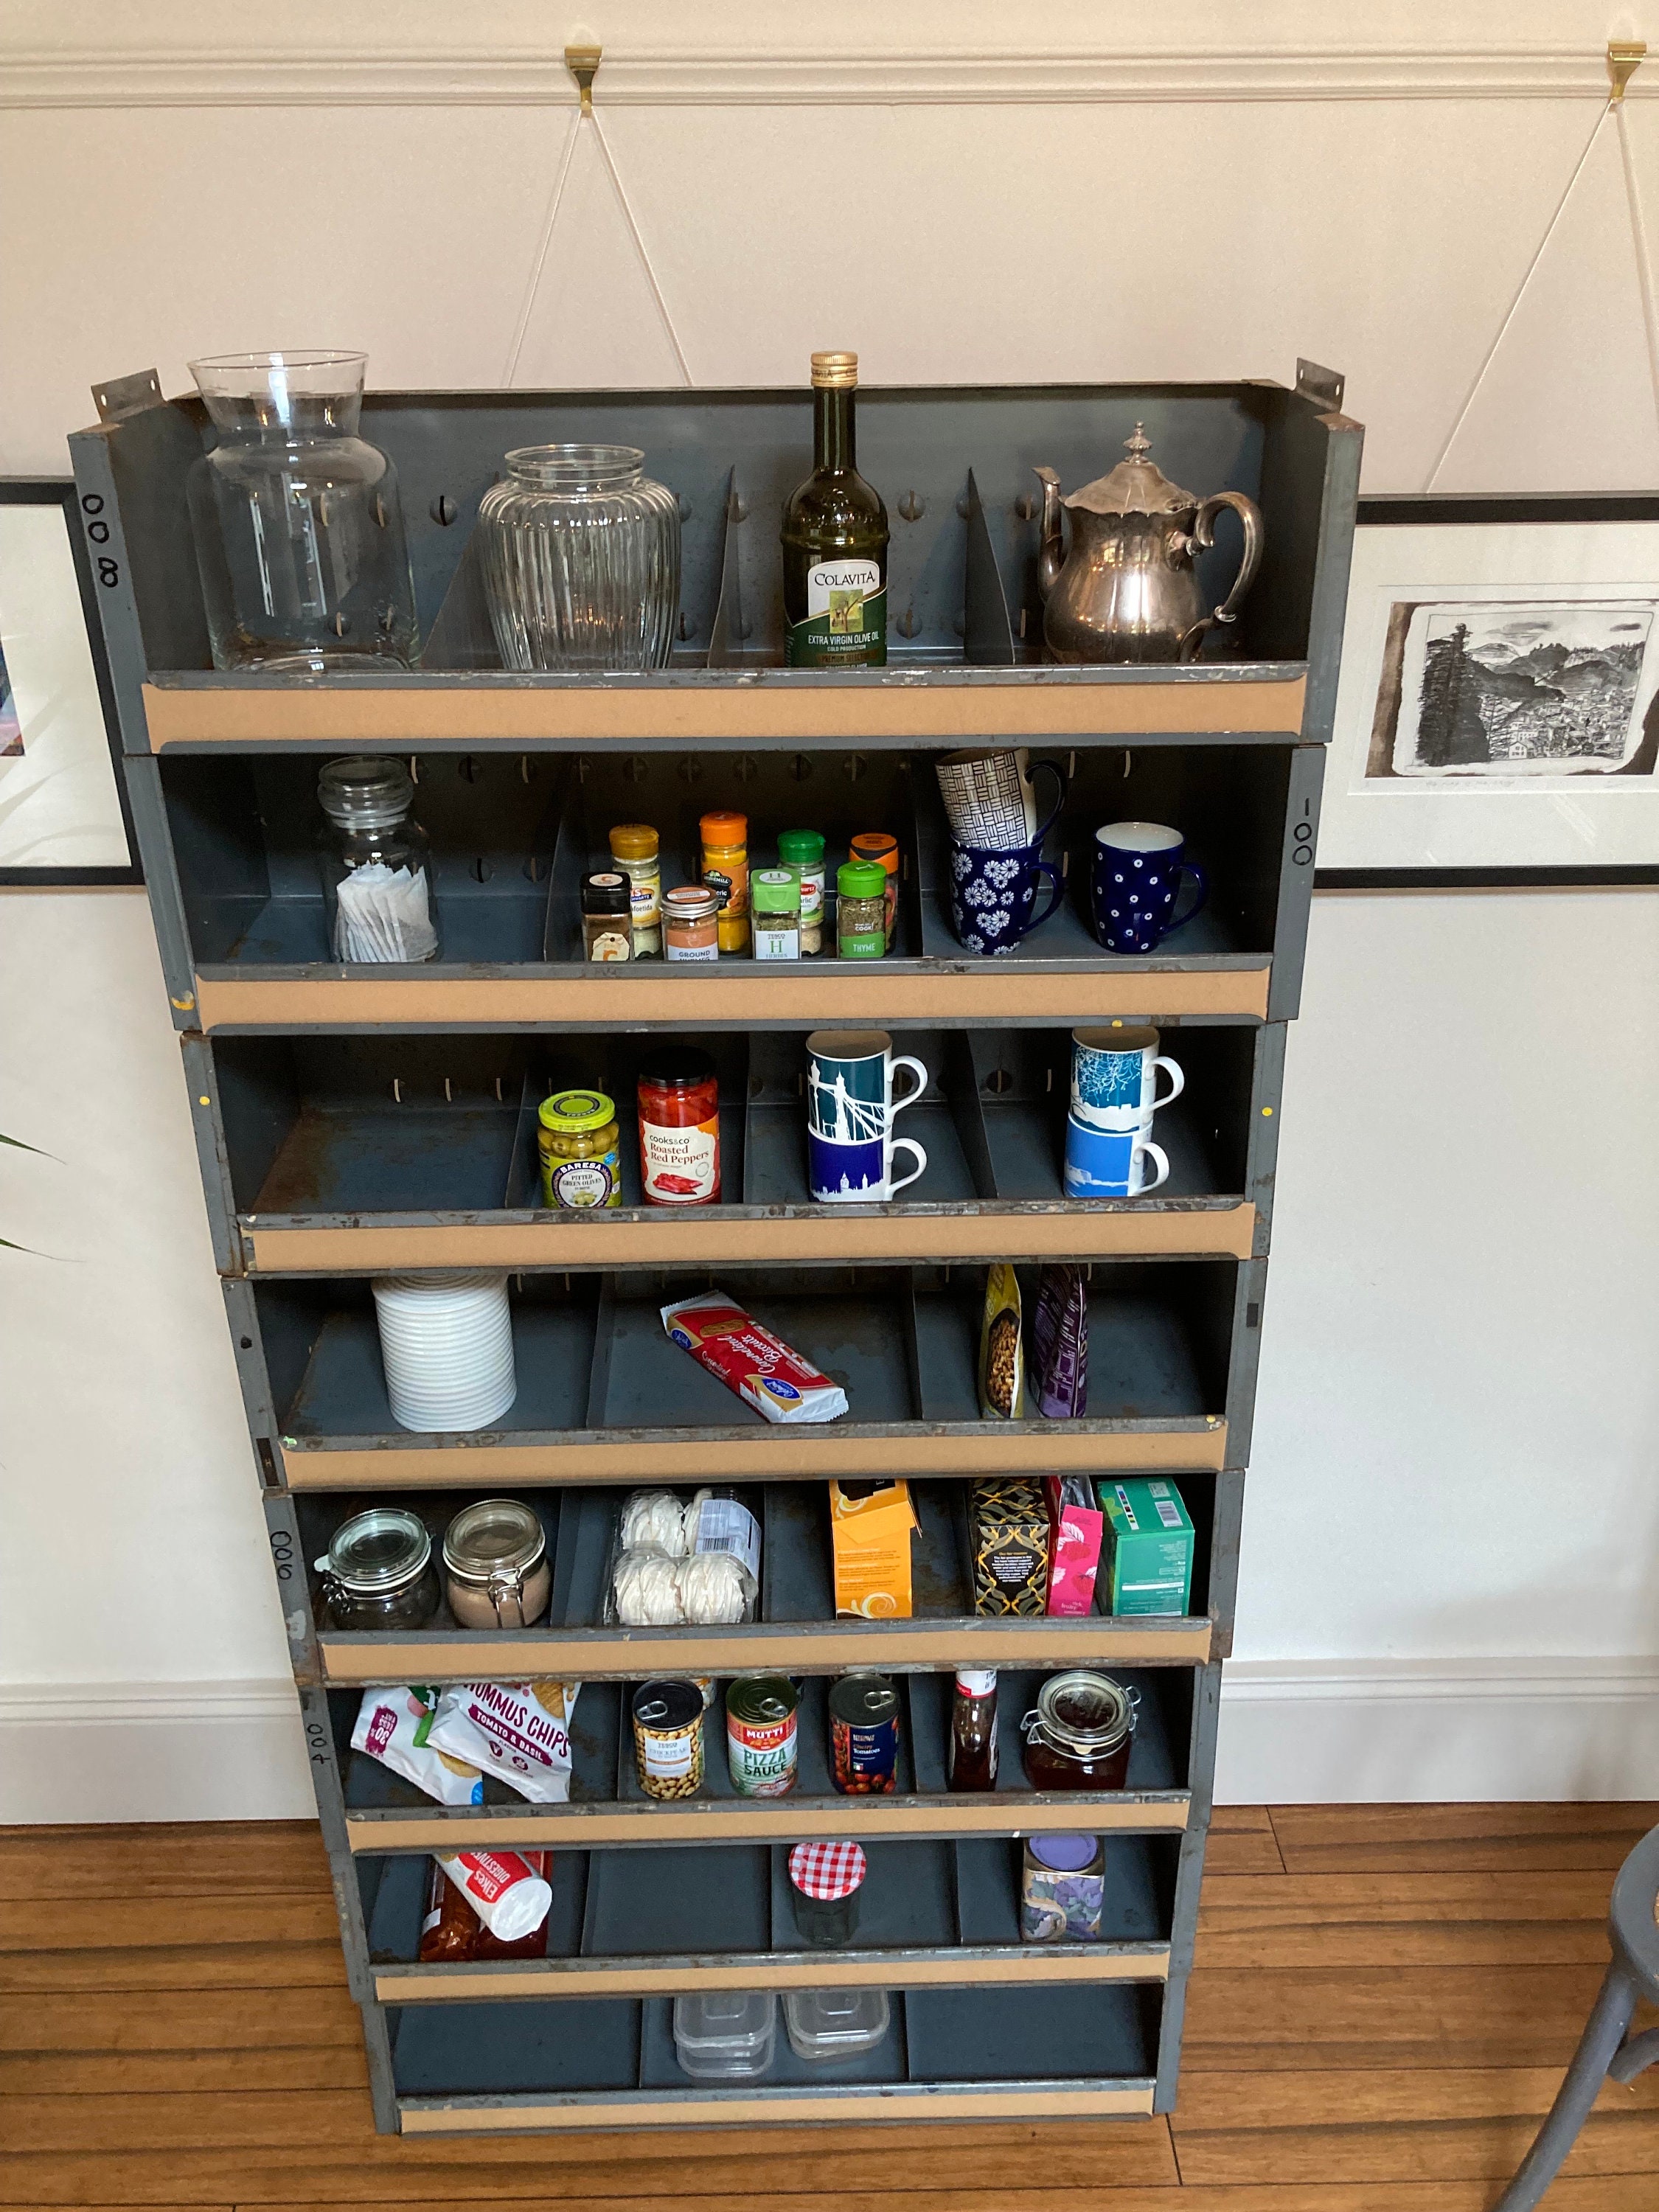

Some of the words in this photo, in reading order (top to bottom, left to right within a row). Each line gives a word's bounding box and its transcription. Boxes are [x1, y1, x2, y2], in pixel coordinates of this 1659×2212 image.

[815, 571, 876, 586] COLAVITA
[808, 635, 829, 645] EXTRA
[830, 634, 853, 645] VIRGIN
[854, 633, 871, 644] OLIVE
[853, 943, 876, 953] THYME
[650, 1135, 689, 1145] cooks&co
[650, 1143, 689, 1155] Roasted
[651, 1152, 668, 1163] Red
[671, 1151, 709, 1165] Peppers
[560, 1163, 602, 1174] BARESA
[742, 1335, 783, 1364] Biscuits
[370, 1727, 390, 1745] 30%
[476, 1711, 508, 1738] TOMATO
[510, 1736, 517, 1745] &
[519, 1740, 543, 1762] BASIL
[527, 1716, 569, 1758] CHIPS
[746, 1727, 783, 1739] MUTTI
[744, 1747, 787, 1766] PIZZA
[744, 1761, 787, 1777] SAUCE
